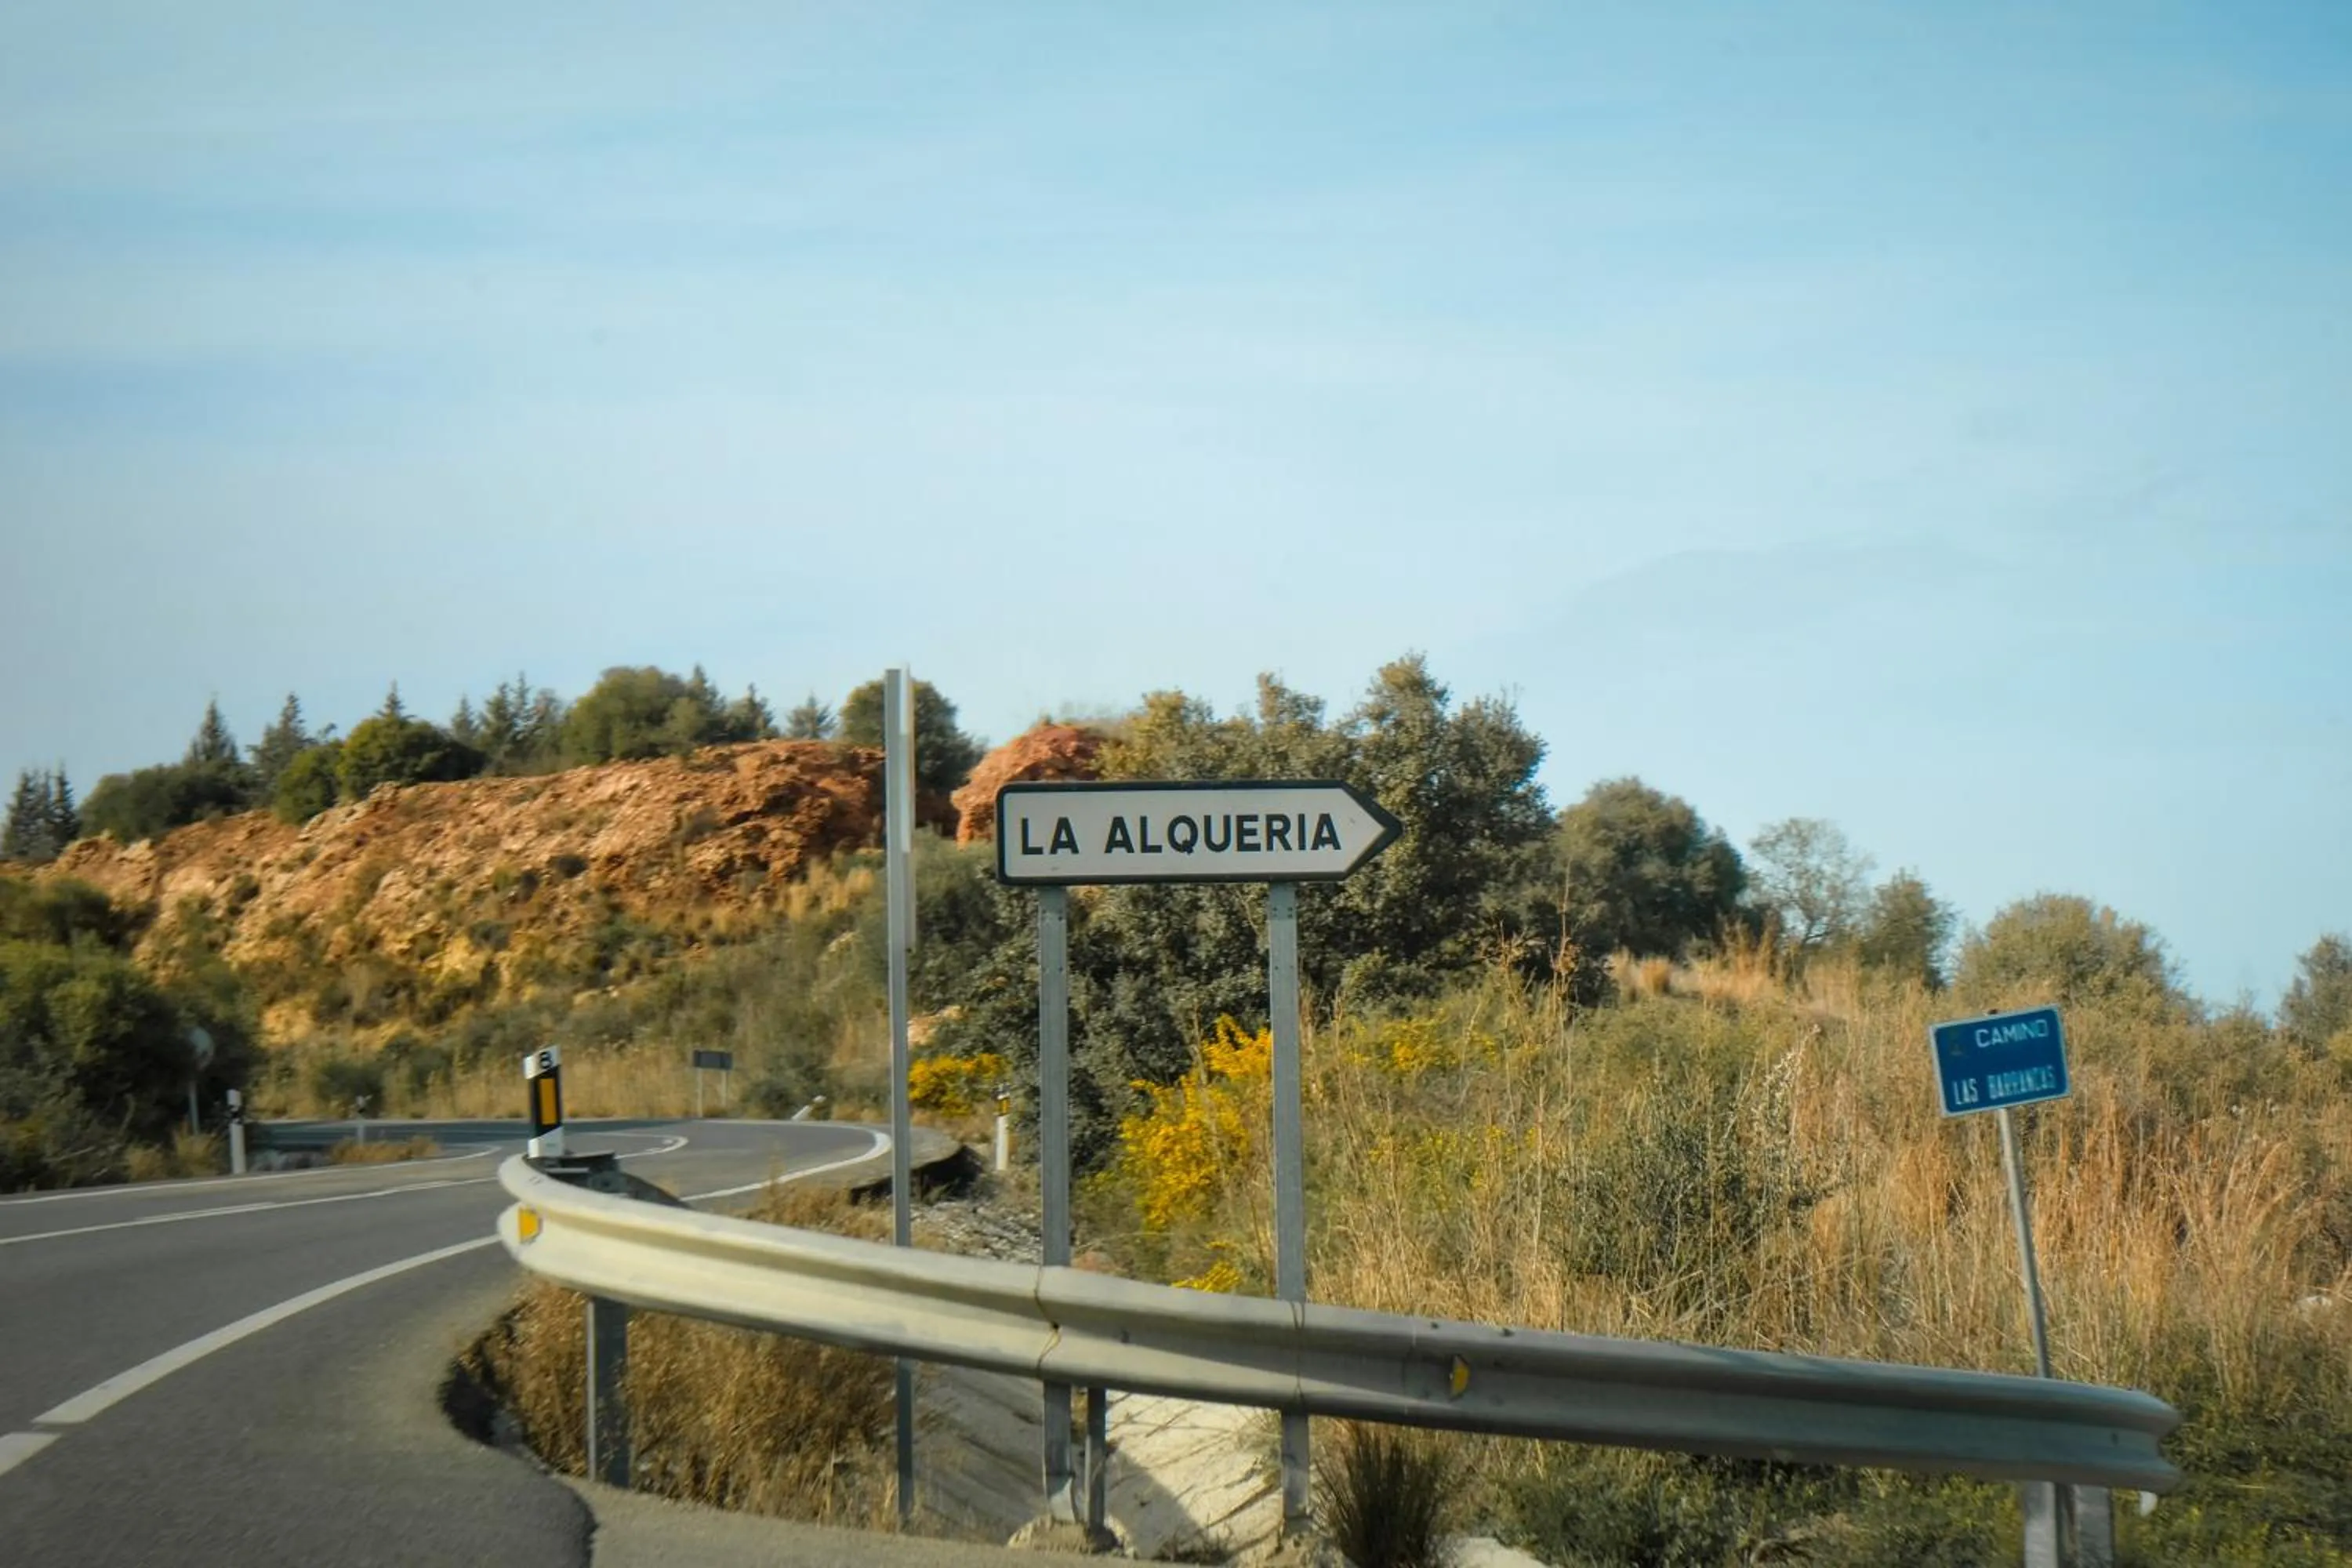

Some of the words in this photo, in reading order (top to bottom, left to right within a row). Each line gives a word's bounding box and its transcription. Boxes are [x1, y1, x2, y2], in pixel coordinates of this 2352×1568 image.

[1021, 816, 1080, 855] LA
[1104, 812, 1342, 855] ALQUERIA
[1975, 1019, 2049, 1047] CAMINO
[1953, 1078, 1979, 1105] LAS
